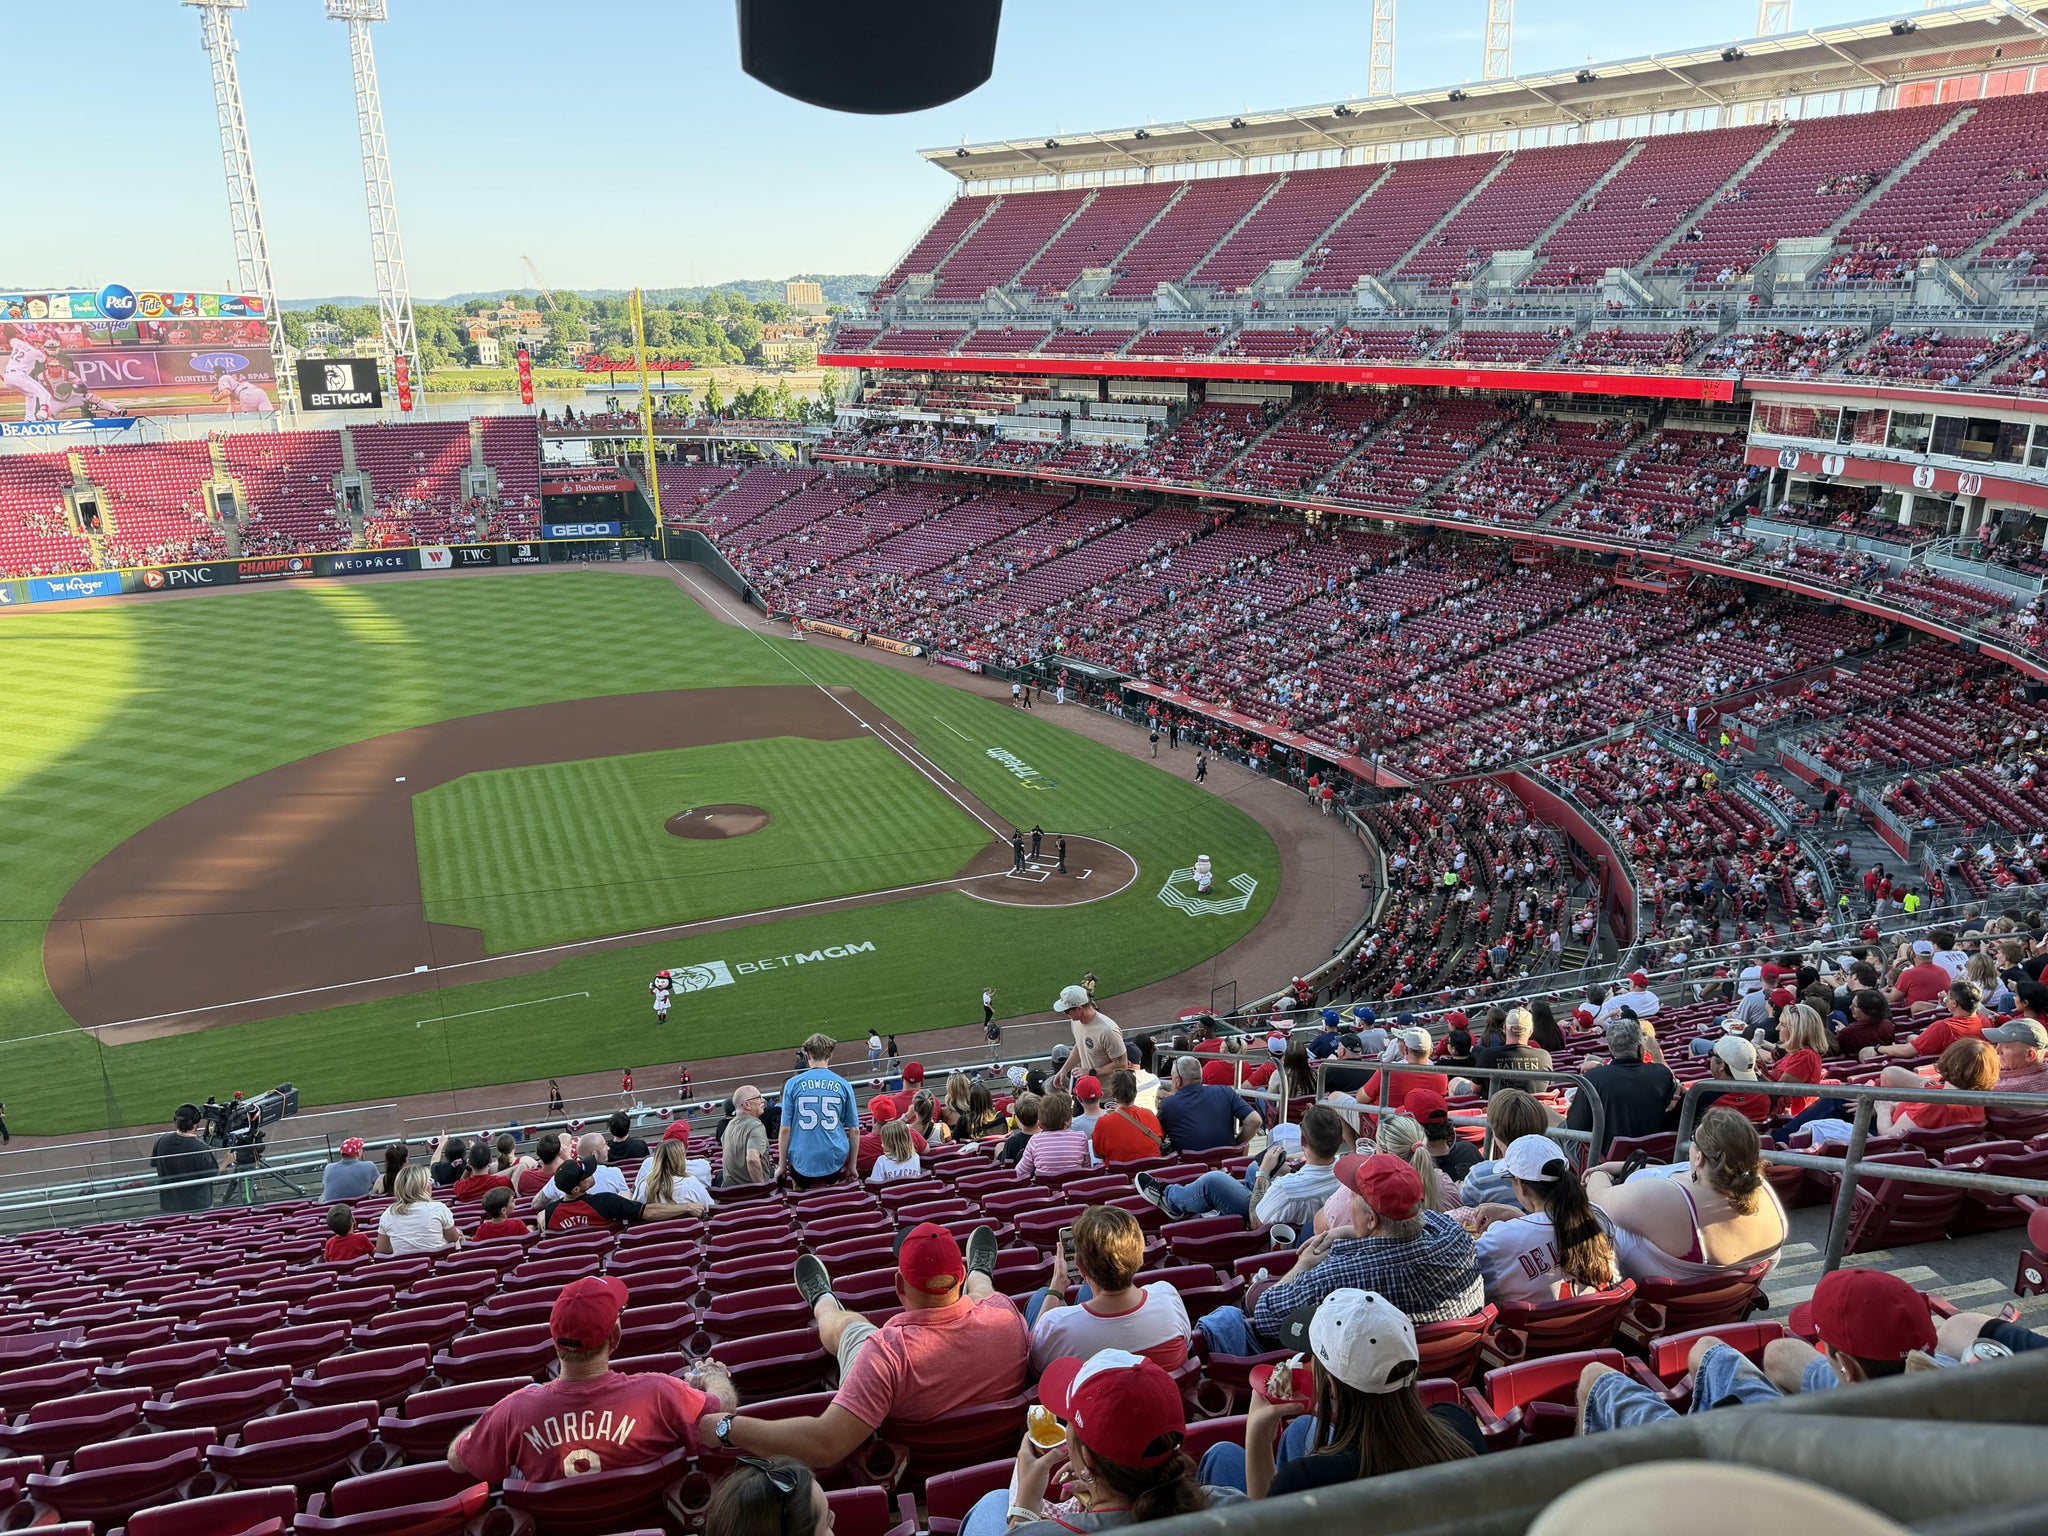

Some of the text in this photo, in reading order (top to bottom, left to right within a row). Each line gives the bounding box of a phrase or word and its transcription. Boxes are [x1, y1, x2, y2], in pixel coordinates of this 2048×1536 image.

[105, 295, 133, 308] P&G
[140, 299, 161, 313] Tide
[89, 320, 131, 332] Swffer
[204, 356, 235, 369] ACR
[73, 359, 145, 382] PNC
[174, 375, 207, 383] GUNITE
[247, 372, 270, 380] SPAS
[311, 392, 373, 406] BETMGM
[2, 423, 57, 436] BEACON
[1779, 450, 1796, 468] 42
[1828, 455, 1837, 473] 1
[1919, 468, 1930, 486] 5
[1960, 473, 1979, 495] 20
[575, 483, 617, 492] Budweiser
[552, 523, 610, 536] GEICO
[460, 548, 491, 560] TWC
[238, 558, 312, 574] CHAMPION
[335, 556, 402, 570] MEDPACE
[166, 568, 213, 585] PNC
[66, 577, 103, 595] Kroger
[1668, 740, 1705, 763] SCOUTS CLUB
[735, 940, 877, 975] BETMGM
[1497, 1062, 1539, 1071] FALLEN
[801, 1079, 841, 1093] POWERS
[798, 1096, 841, 1131] 55
[559, 1215, 589, 1230] VOTTO
[522, 1409, 637, 1456] MORGAN
